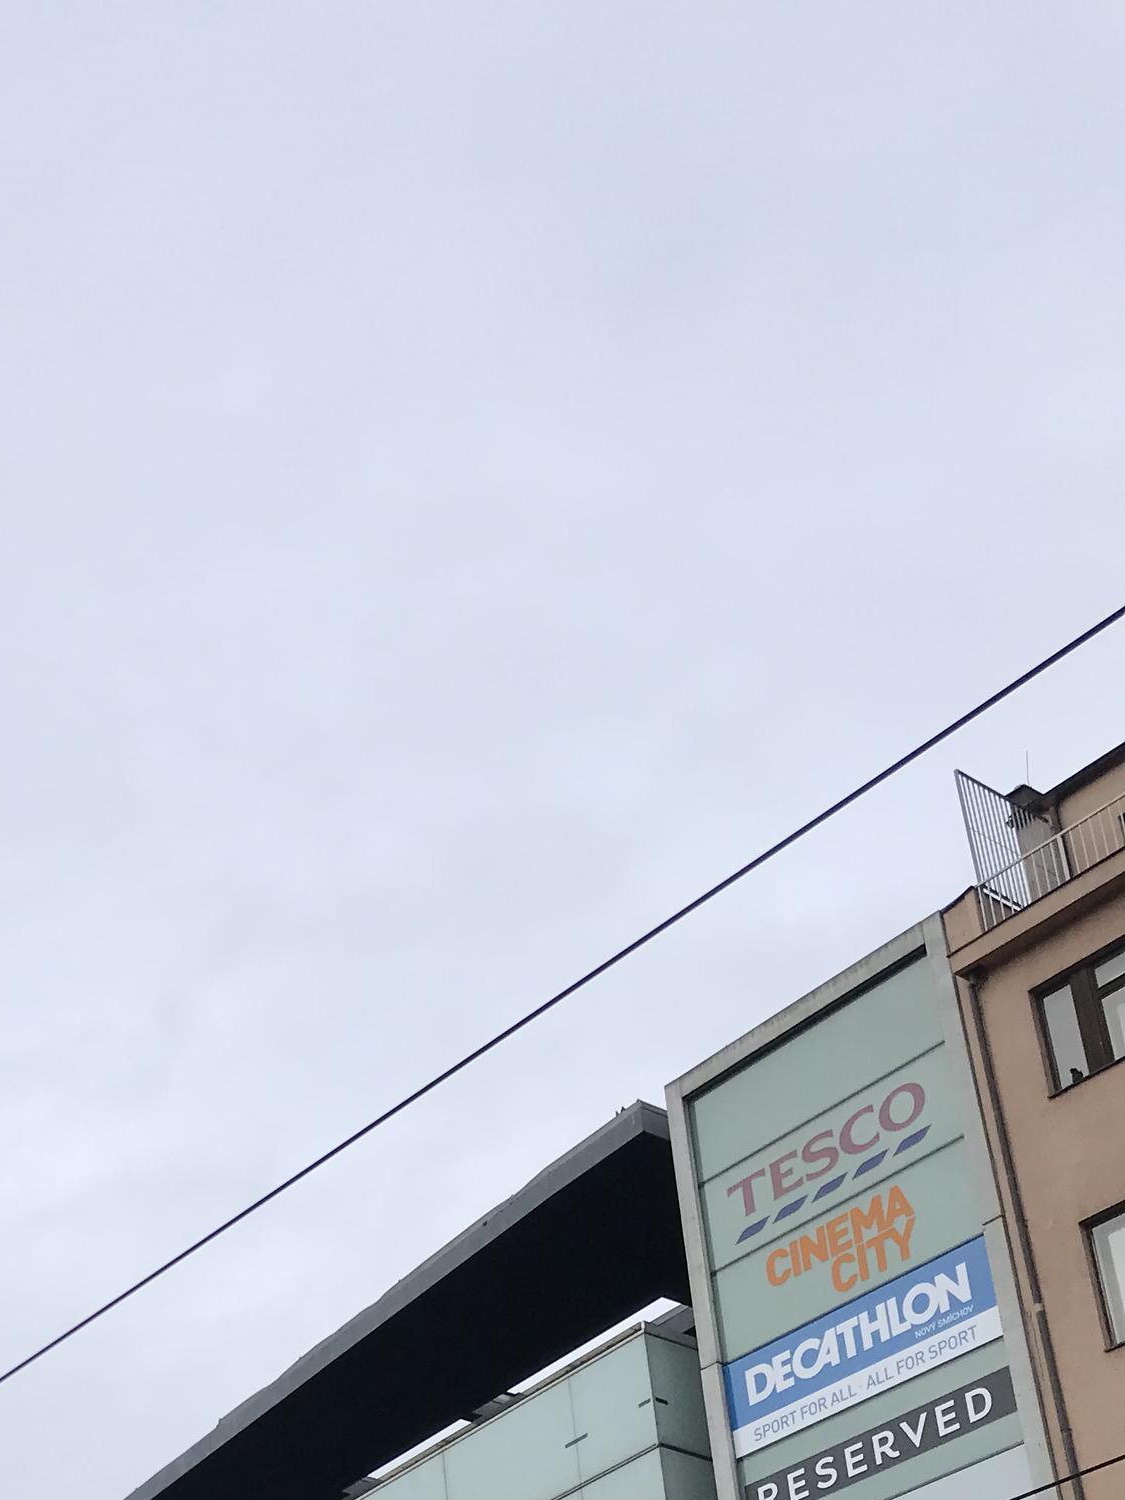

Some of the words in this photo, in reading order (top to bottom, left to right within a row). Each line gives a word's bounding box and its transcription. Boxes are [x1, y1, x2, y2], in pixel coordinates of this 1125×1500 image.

[726, 1082, 926, 1216] TESCO
[766, 1185, 915, 1287] CINEMA
[831, 1217, 916, 1292] CITY
[745, 1262, 972, 1406] DECATHLON
[753, 1410, 797, 1442] SPORT
[800, 1398, 828, 1422] FOR
[830, 1388, 858, 1406] ALL
[866, 1366, 895, 1390] ALL
[896, 1351, 926, 1376] FOR
[929, 1325, 978, 1361] SPORT
